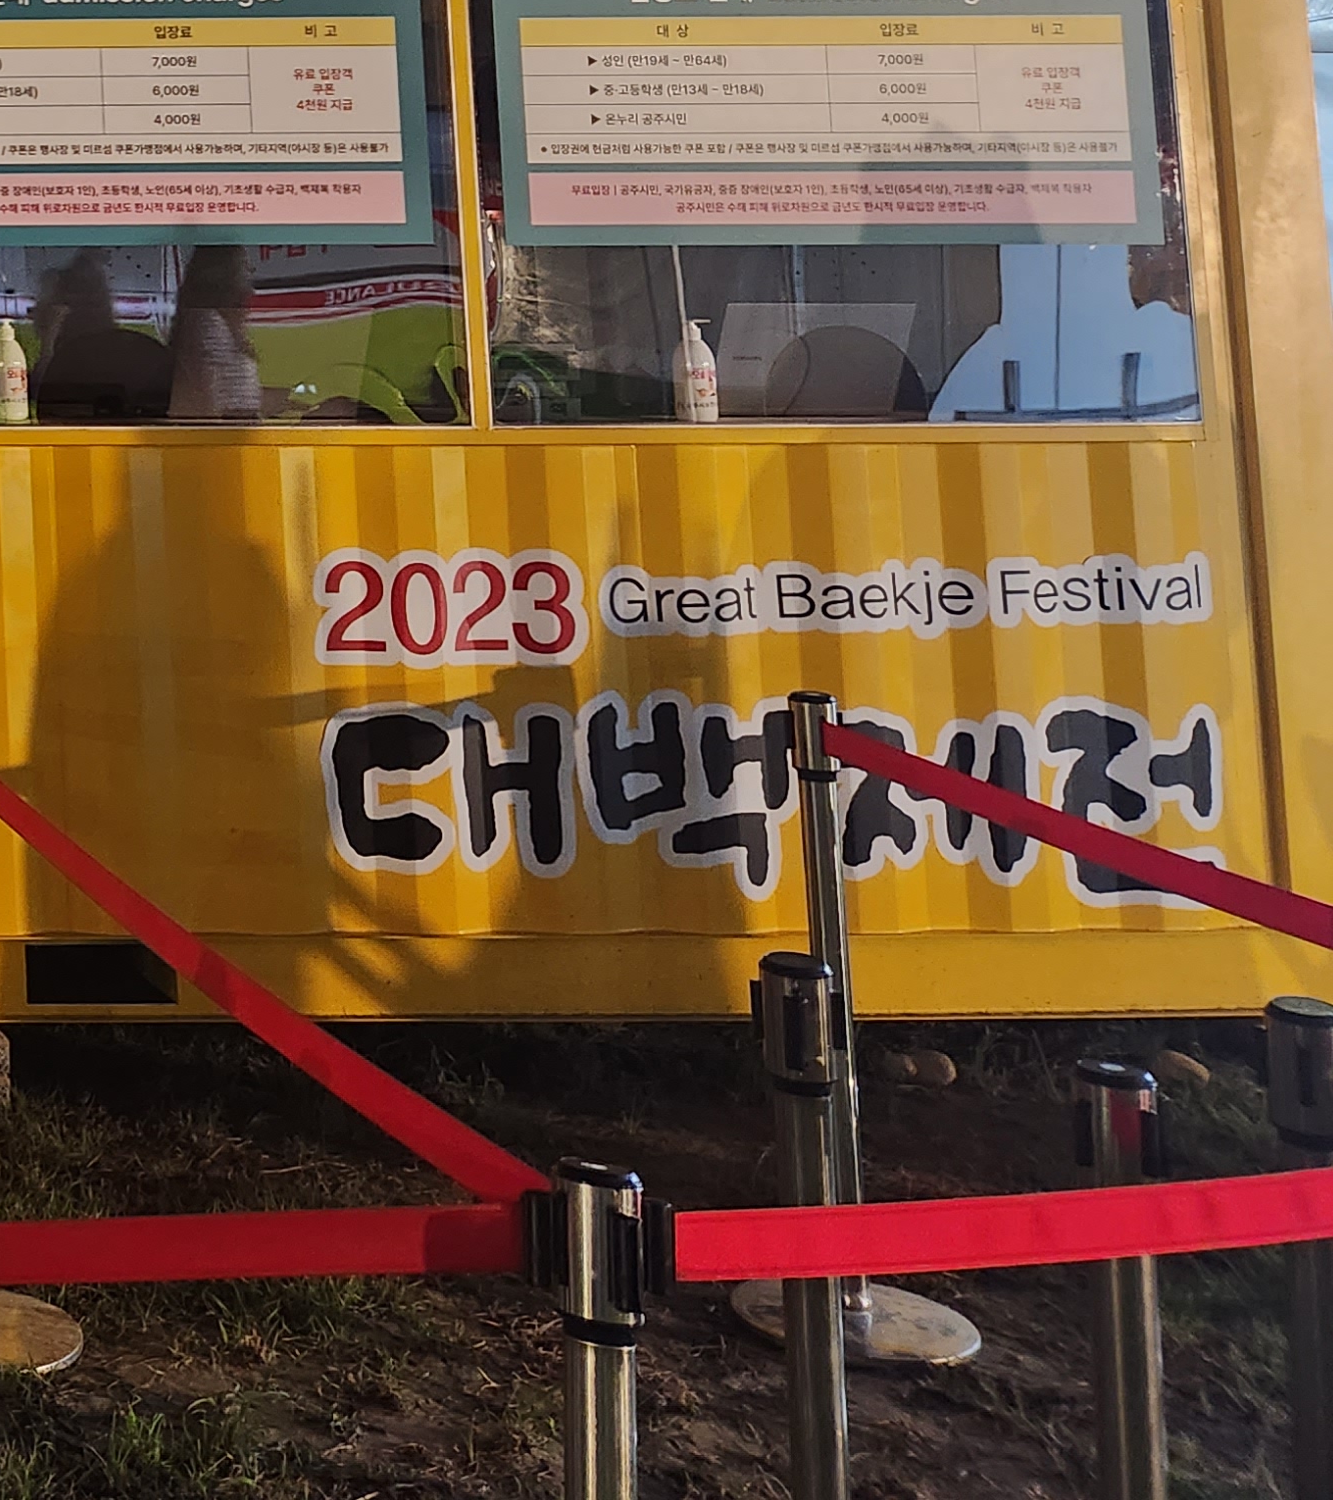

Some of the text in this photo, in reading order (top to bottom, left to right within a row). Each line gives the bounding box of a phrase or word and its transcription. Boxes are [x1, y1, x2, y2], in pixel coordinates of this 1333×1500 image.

[153, 24, 193, 39] 입장료
[878, 22, 919, 37] 입장료
[150, 51, 197, 69] 7,000원
[600, 53, 624, 67] 성인
[626, 53, 669, 69] (만19세
[682, 53, 727, 68] 만64세)
[876, 53, 923, 67] 7,000원
[292, 67, 353, 80] 유료 입장객
[151, 83, 199, 98] 6,000원
[311, 82, 335, 96] 쿠폰
[878, 82, 926, 96] 6,000원
[295, 97, 353, 111] 4천원 지급
[153, 112, 201, 127] 4,000원
[604, 111, 687, 126] 온누리 공주시민
[880, 111, 929, 126] 4,000원
[327, 561, 1202, 654] 2023 Great Baekje Festival
